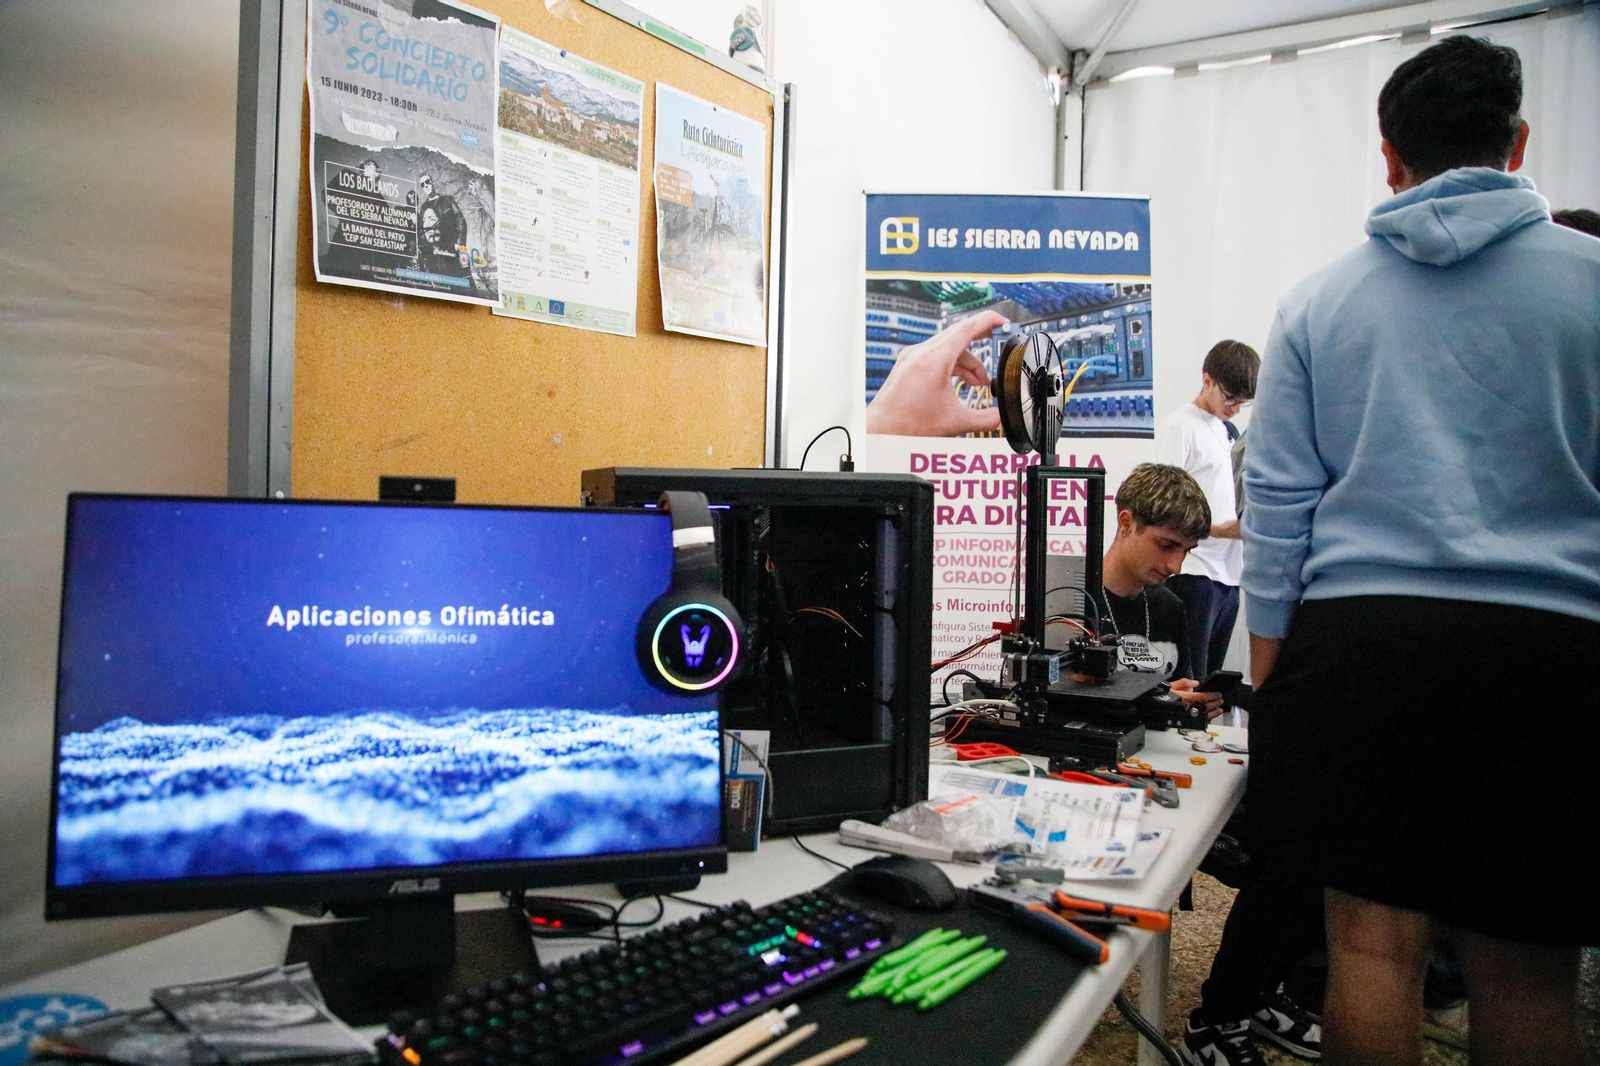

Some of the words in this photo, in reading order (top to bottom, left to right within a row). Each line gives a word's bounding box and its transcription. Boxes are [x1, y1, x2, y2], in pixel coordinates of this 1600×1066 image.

[358, 22, 487, 83] CONCIERTO
[502, 32, 535, 54] Semana
[540, 46, 580, 71] Cultural
[585, 67, 616, 85] AGOSTO
[345, 46, 468, 102] SOLIDARIO
[320, 76, 331, 88] 15
[333, 79, 359, 95] JUNIO
[361, 87, 383, 103] 2023
[390, 96, 418, 112] 18:30h
[442, 113, 462, 125] Sierra
[464, 119, 487, 132] Nevada
[683, 118, 700, 143] Ruta
[702, 126, 743, 158] Cicloturística
[339, 171, 355, 188] LOS
[356, 175, 400, 198] BADLANDS
[327, 194, 375, 213] PROFESORADO
[375, 205, 380, 213] Y
[381, 207, 416, 221] ALUMNADO
[336, 205, 349, 216] DEL
[350, 208, 360, 218] IES
[361, 210, 383, 223] SIERRA
[383, 215, 409, 228] NEVADA
[341, 222, 351, 232] LA
[351, 224, 375, 236] BANDA
[374, 228, 387, 239] DEL
[387, 231, 406, 243] PATIO
[360, 235, 373, 246] SAN
[928, 228, 958, 248] IES
[964, 228, 1041, 249] SIERRA
[1048, 229, 1139, 251] NEVADA
[910, 453, 1107, 474] DESARRA
[926, 479, 1027, 500] UTUR
[1051, 480, 1087, 501] EN
[936, 505, 978, 525] RA
[985, 505, 1087, 527] DITA
[950, 538, 1074, 554] INFORMCA
[933, 555, 1026, 568] OMUNICA
[942, 570, 1007, 584] GRADO
[947, 598, 1026, 612] Microinfo
[266, 604, 432, 631] Aplicaciones
[440, 603, 555, 627] Ofimática
[932, 620, 966, 632] nfigura
[968, 621, 999, 632] Siste
